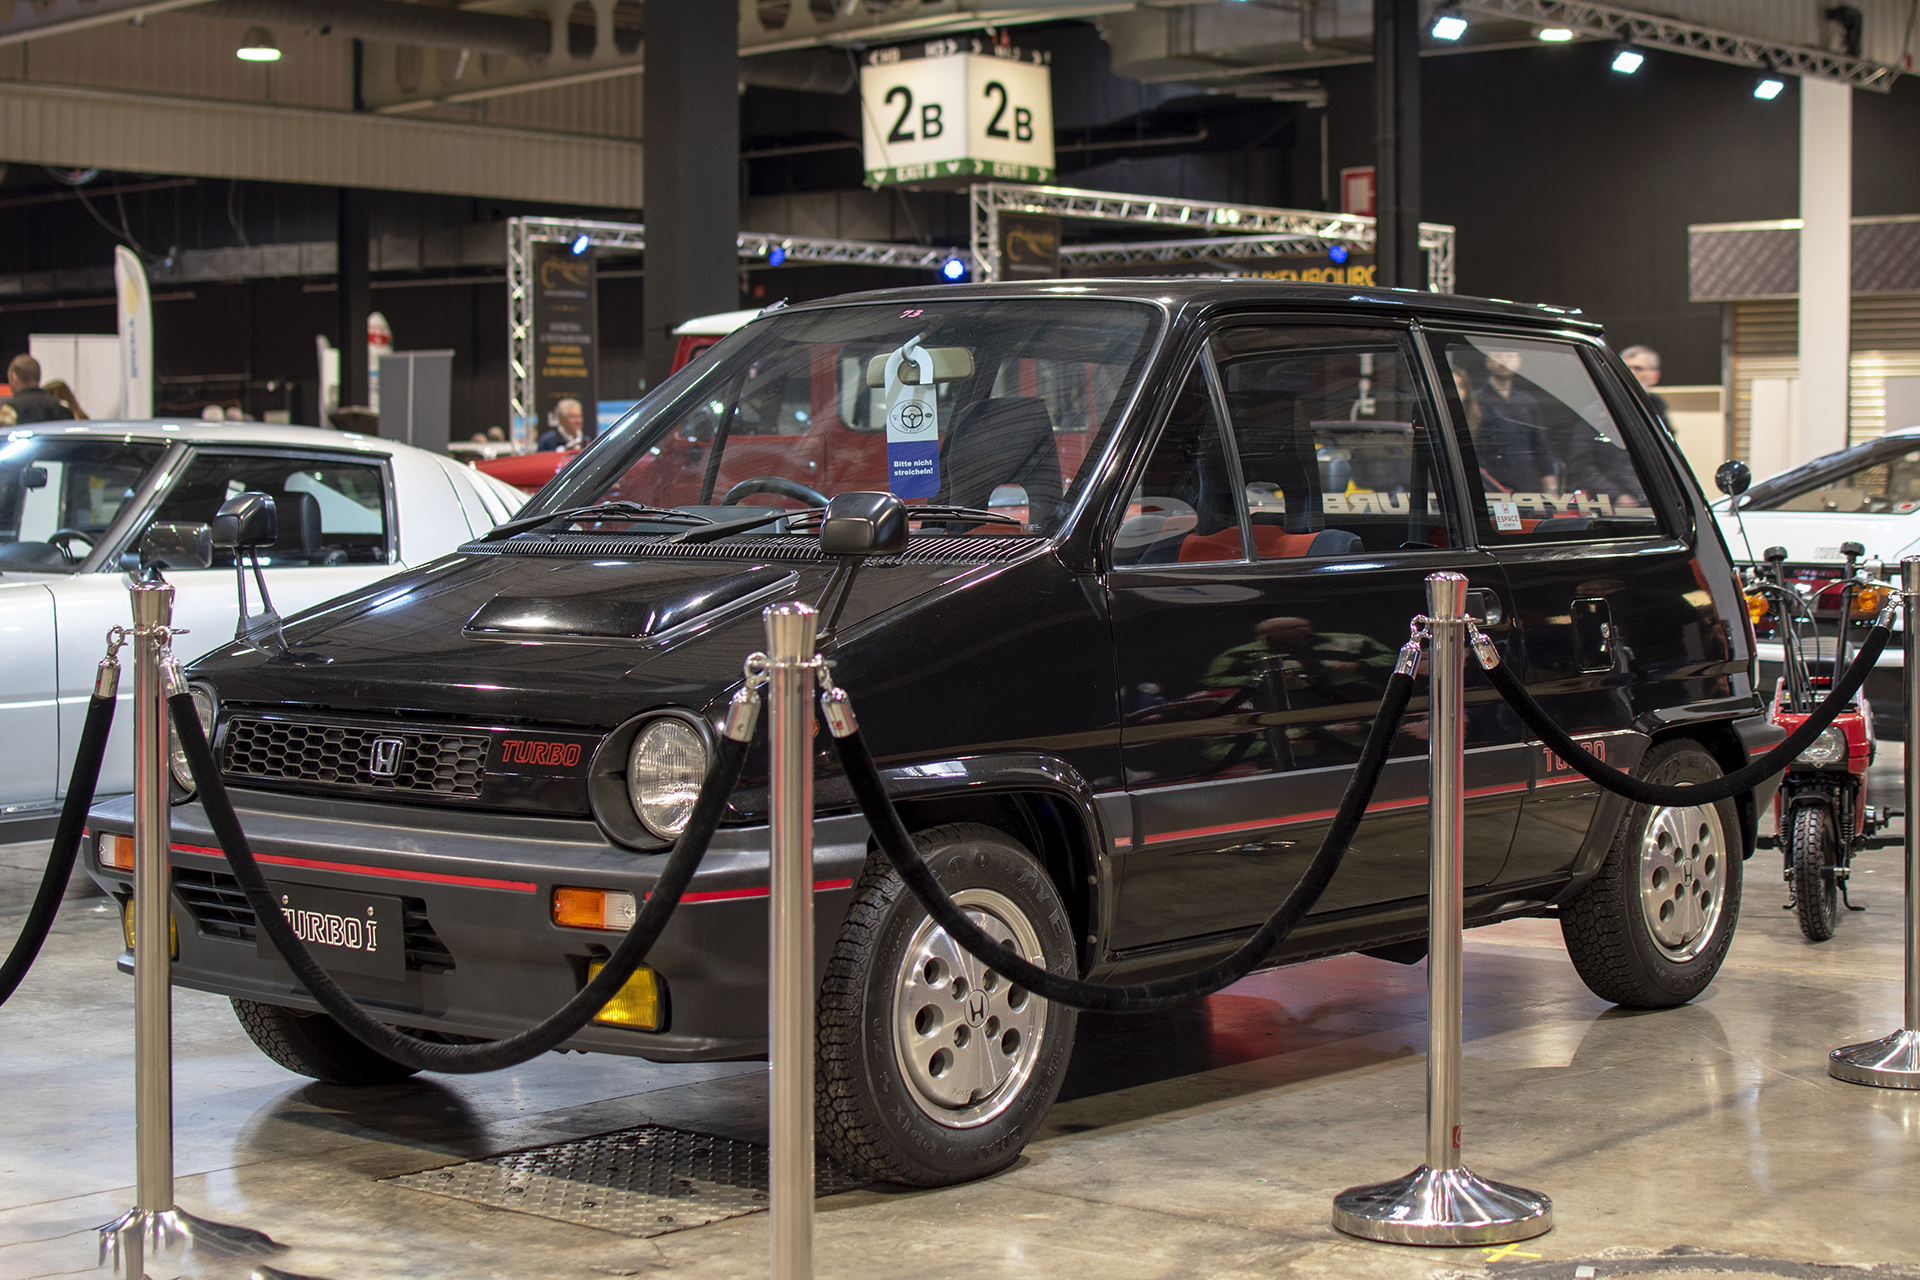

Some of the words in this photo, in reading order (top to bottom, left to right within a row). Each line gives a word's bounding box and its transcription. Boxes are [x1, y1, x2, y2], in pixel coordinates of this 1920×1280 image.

[885, 86, 944, 144] 2B
[983, 81, 1033, 142] 2B
[899, 309, 924, 319] 73
[893, 460, 912, 468] Bitte
[913, 459, 933, 467] nicht
[893, 467, 934, 477] streicheln!
[1496, 514, 1519, 523] ESPACE
[1814, 548, 1847, 559] TRUE
[502, 739, 582, 767] TURBO
[1543, 740, 1606, 772] TUBO
